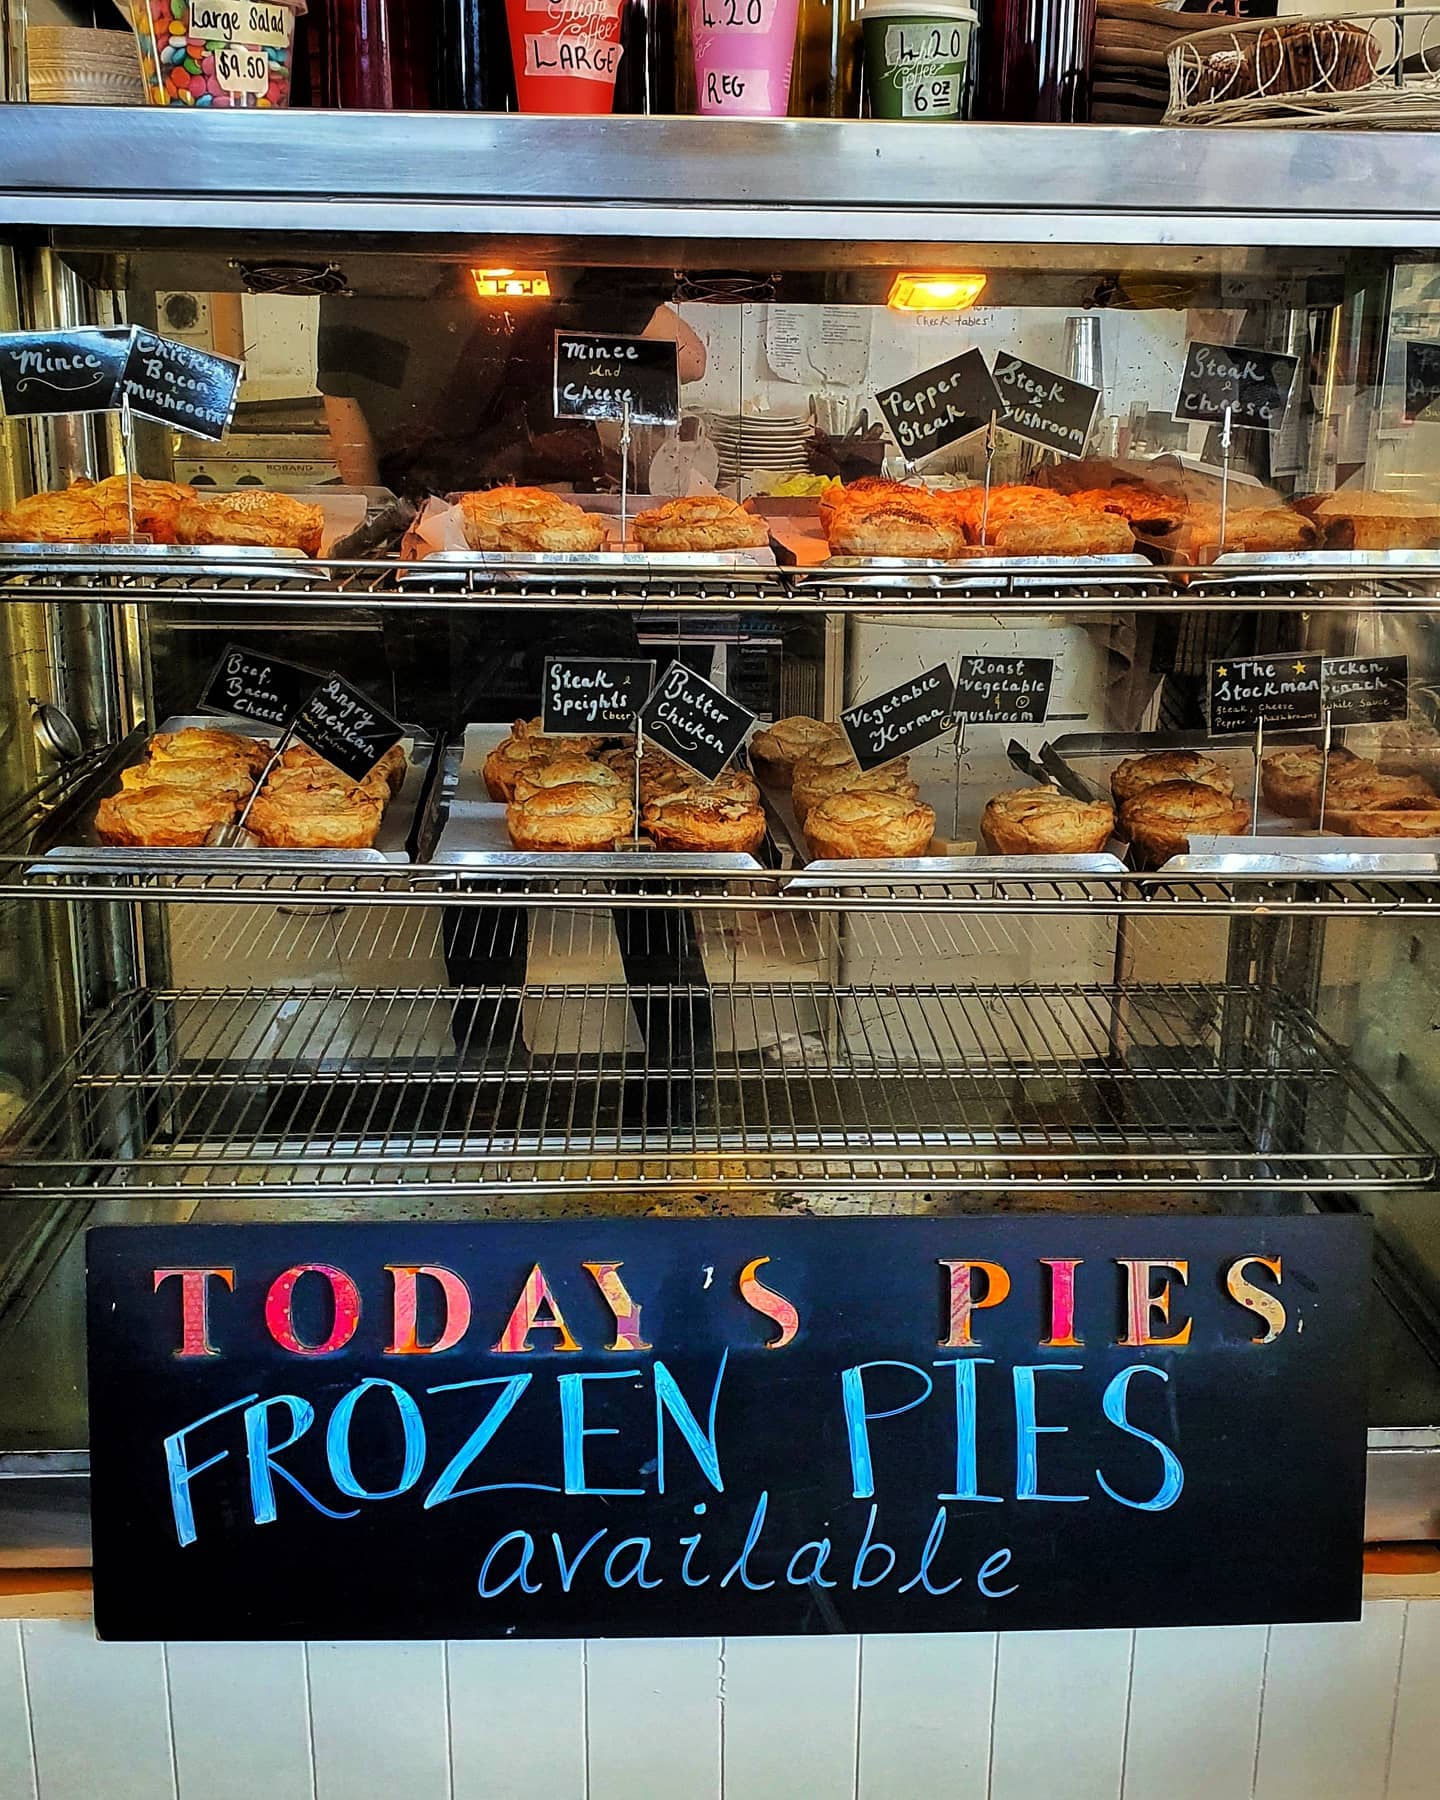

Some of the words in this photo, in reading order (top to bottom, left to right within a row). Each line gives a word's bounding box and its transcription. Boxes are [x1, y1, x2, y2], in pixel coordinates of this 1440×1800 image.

[191, 2, 240, 40] Large
[249, 7, 284, 34] Salad
[702, 0, 762, 28] 4.20
[533, 39, 616, 73] LARGE
[900, 29, 960, 60] 4.20
[219, 51, 265, 80] $9.50
[707, 72, 745, 104] REG
[10, 348, 101, 375] Mince
[562, 338, 639, 359] Mince
[1190, 348, 1265, 381] Steak
[142, 358, 209, 394] Bacon
[563, 382, 633, 402] Cheese
[994, 360, 1065, 403] Steak
[882, 372, 961, 416] Pepper
[1184, 393, 1273, 419] Cheese
[898, 403, 966, 446] Steak
[550, 663, 614, 691] Steak
[968, 658, 1025, 676] Roast
[1233, 661, 1276, 680] The
[226, 677, 279, 702] Bacon
[664, 669, 729, 724] Butter
[843, 677, 941, 728] Vegetable
[959, 678, 1046, 699] Vegetable
[1214, 679, 1320, 701] Stockman
[233, 699, 284, 722] Cheese
[322, 680, 375, 730] Angry
[552, 691, 628, 722] Speights
[657, 702, 725, 755] Chicken
[868, 708, 945, 753] Korma
[152, 1256, 800, 1356] TODAY'S
[936, 1255, 1287, 1348] PIES
[164, 1347, 729, 1548] FROZEN
[841, 1357, 1185, 1512] PIES
[478, 1491, 1020, 1599] available
